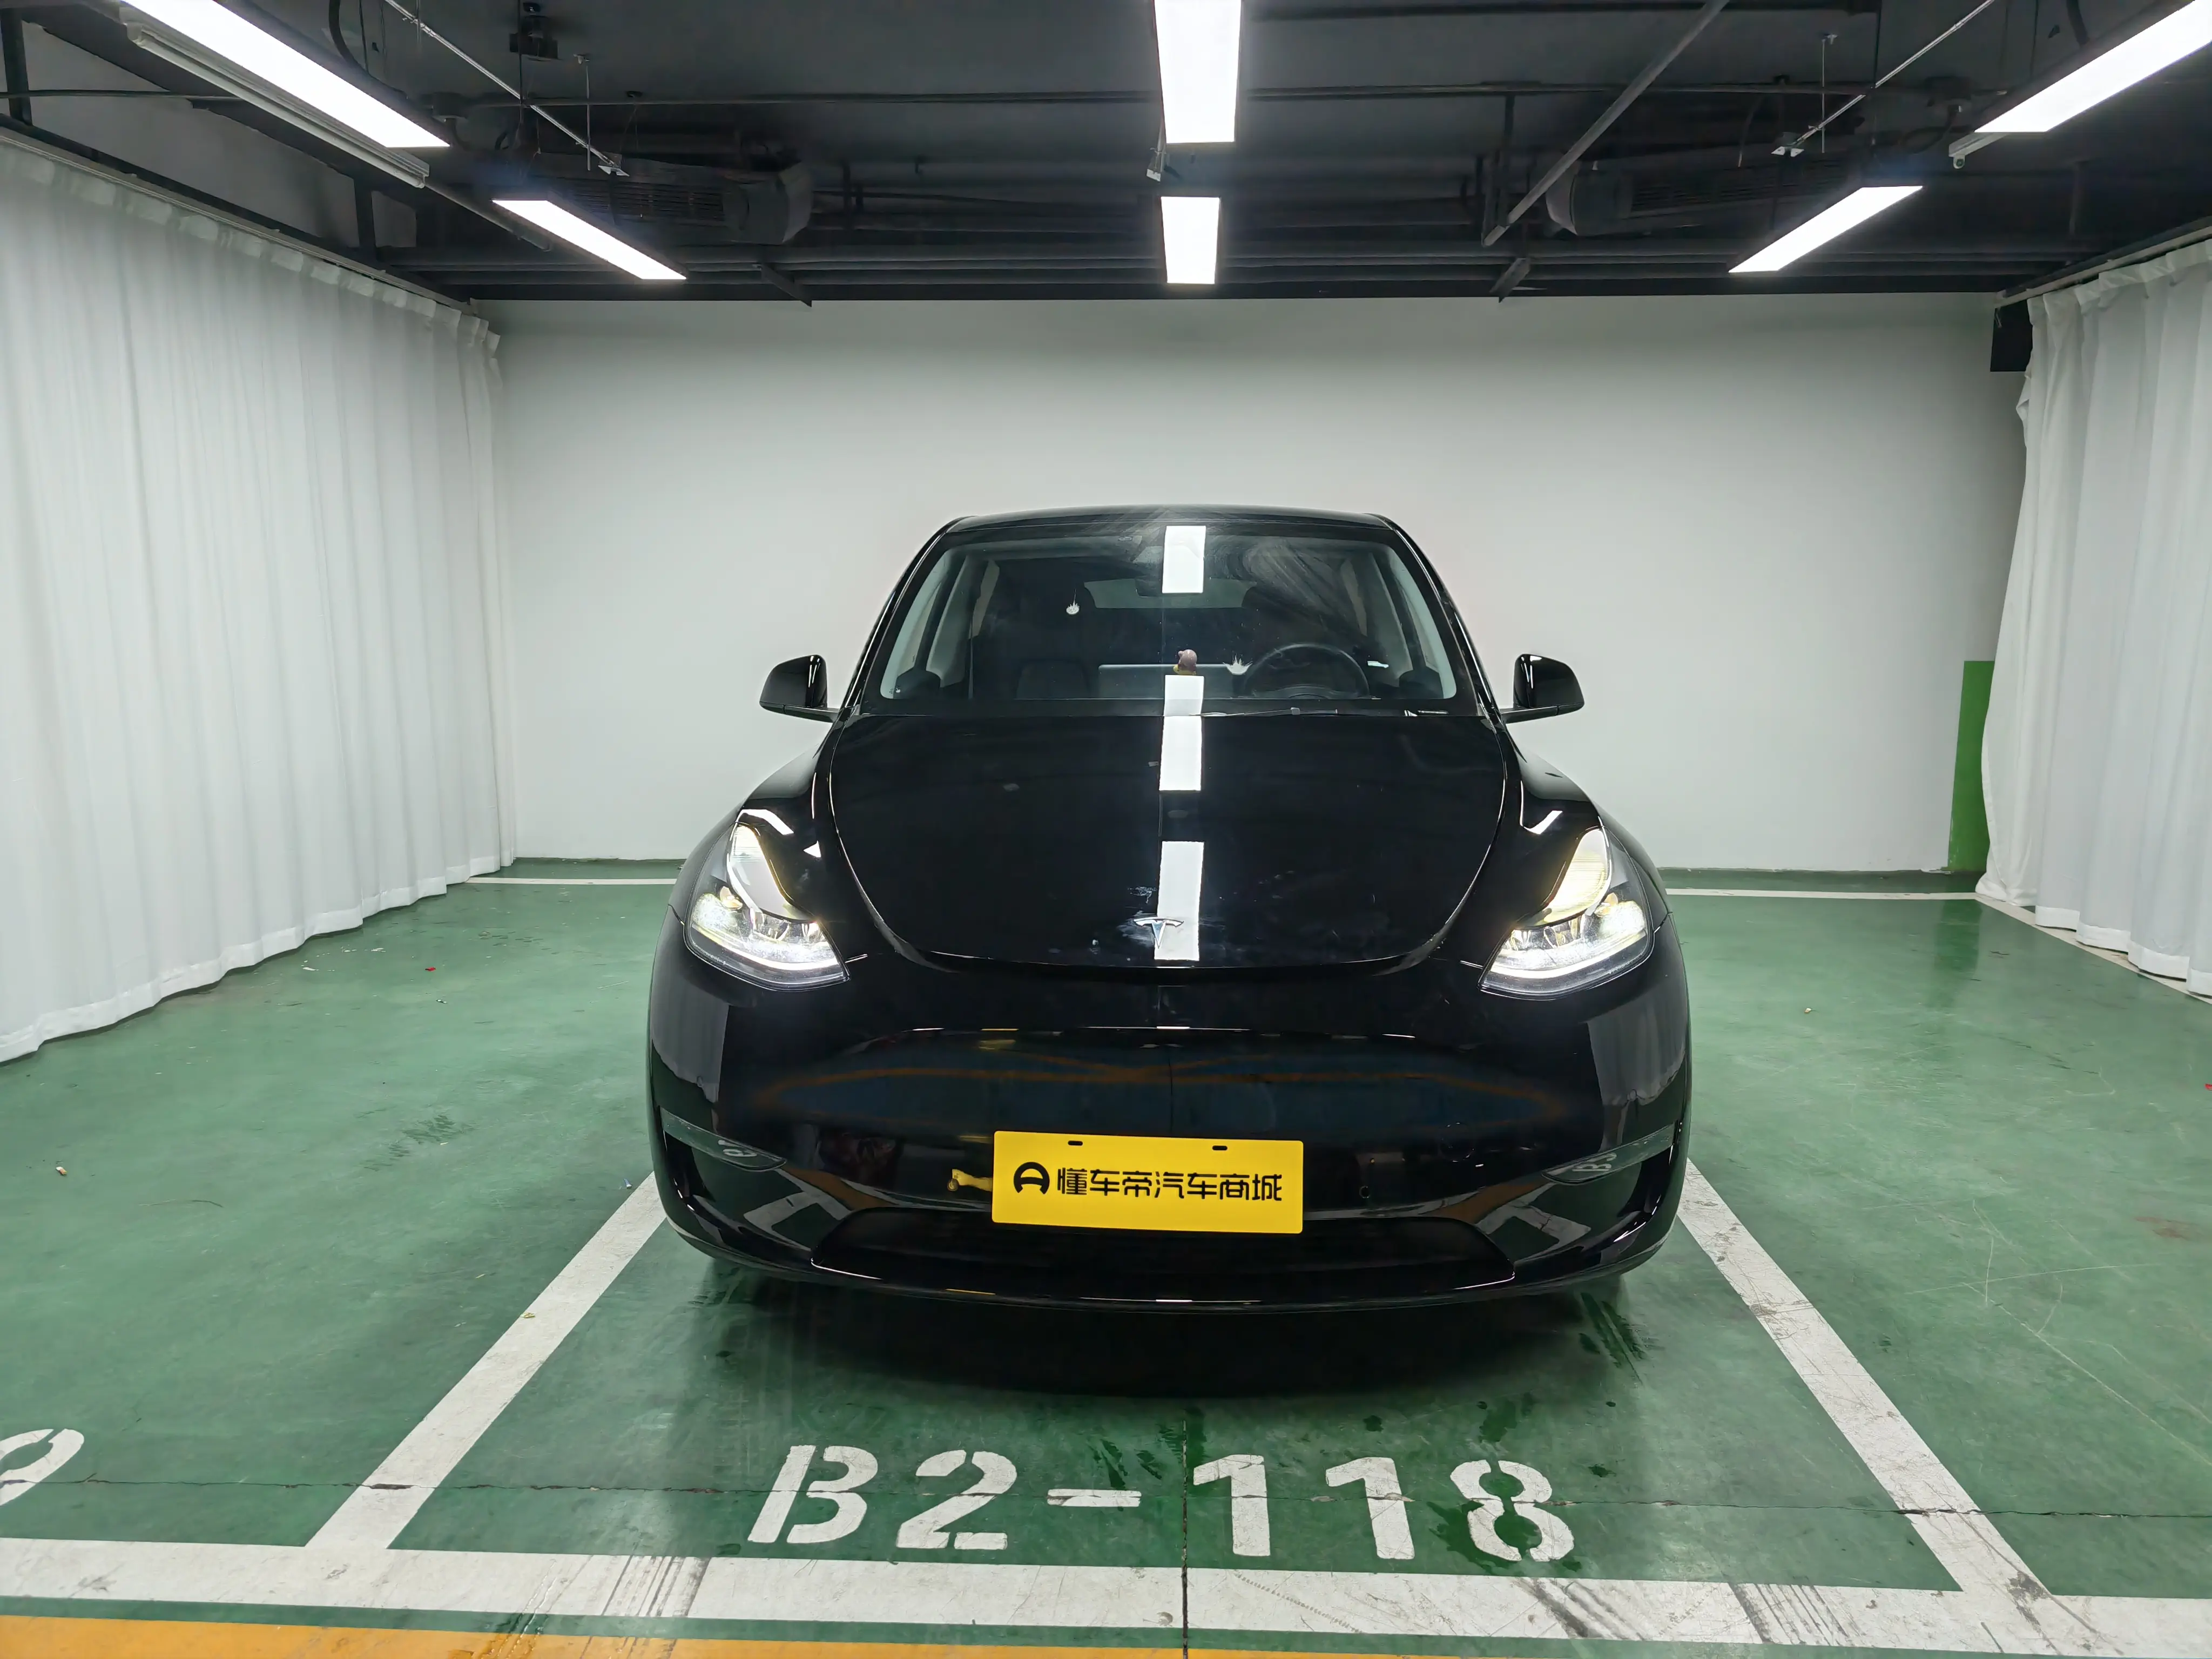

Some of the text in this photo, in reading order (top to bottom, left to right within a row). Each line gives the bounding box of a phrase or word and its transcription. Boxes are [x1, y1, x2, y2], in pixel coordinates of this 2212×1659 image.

[1057, 1167, 1283, 1202] 懂车帝汽车商城
[747, 1444, 1574, 1562] B2-118
